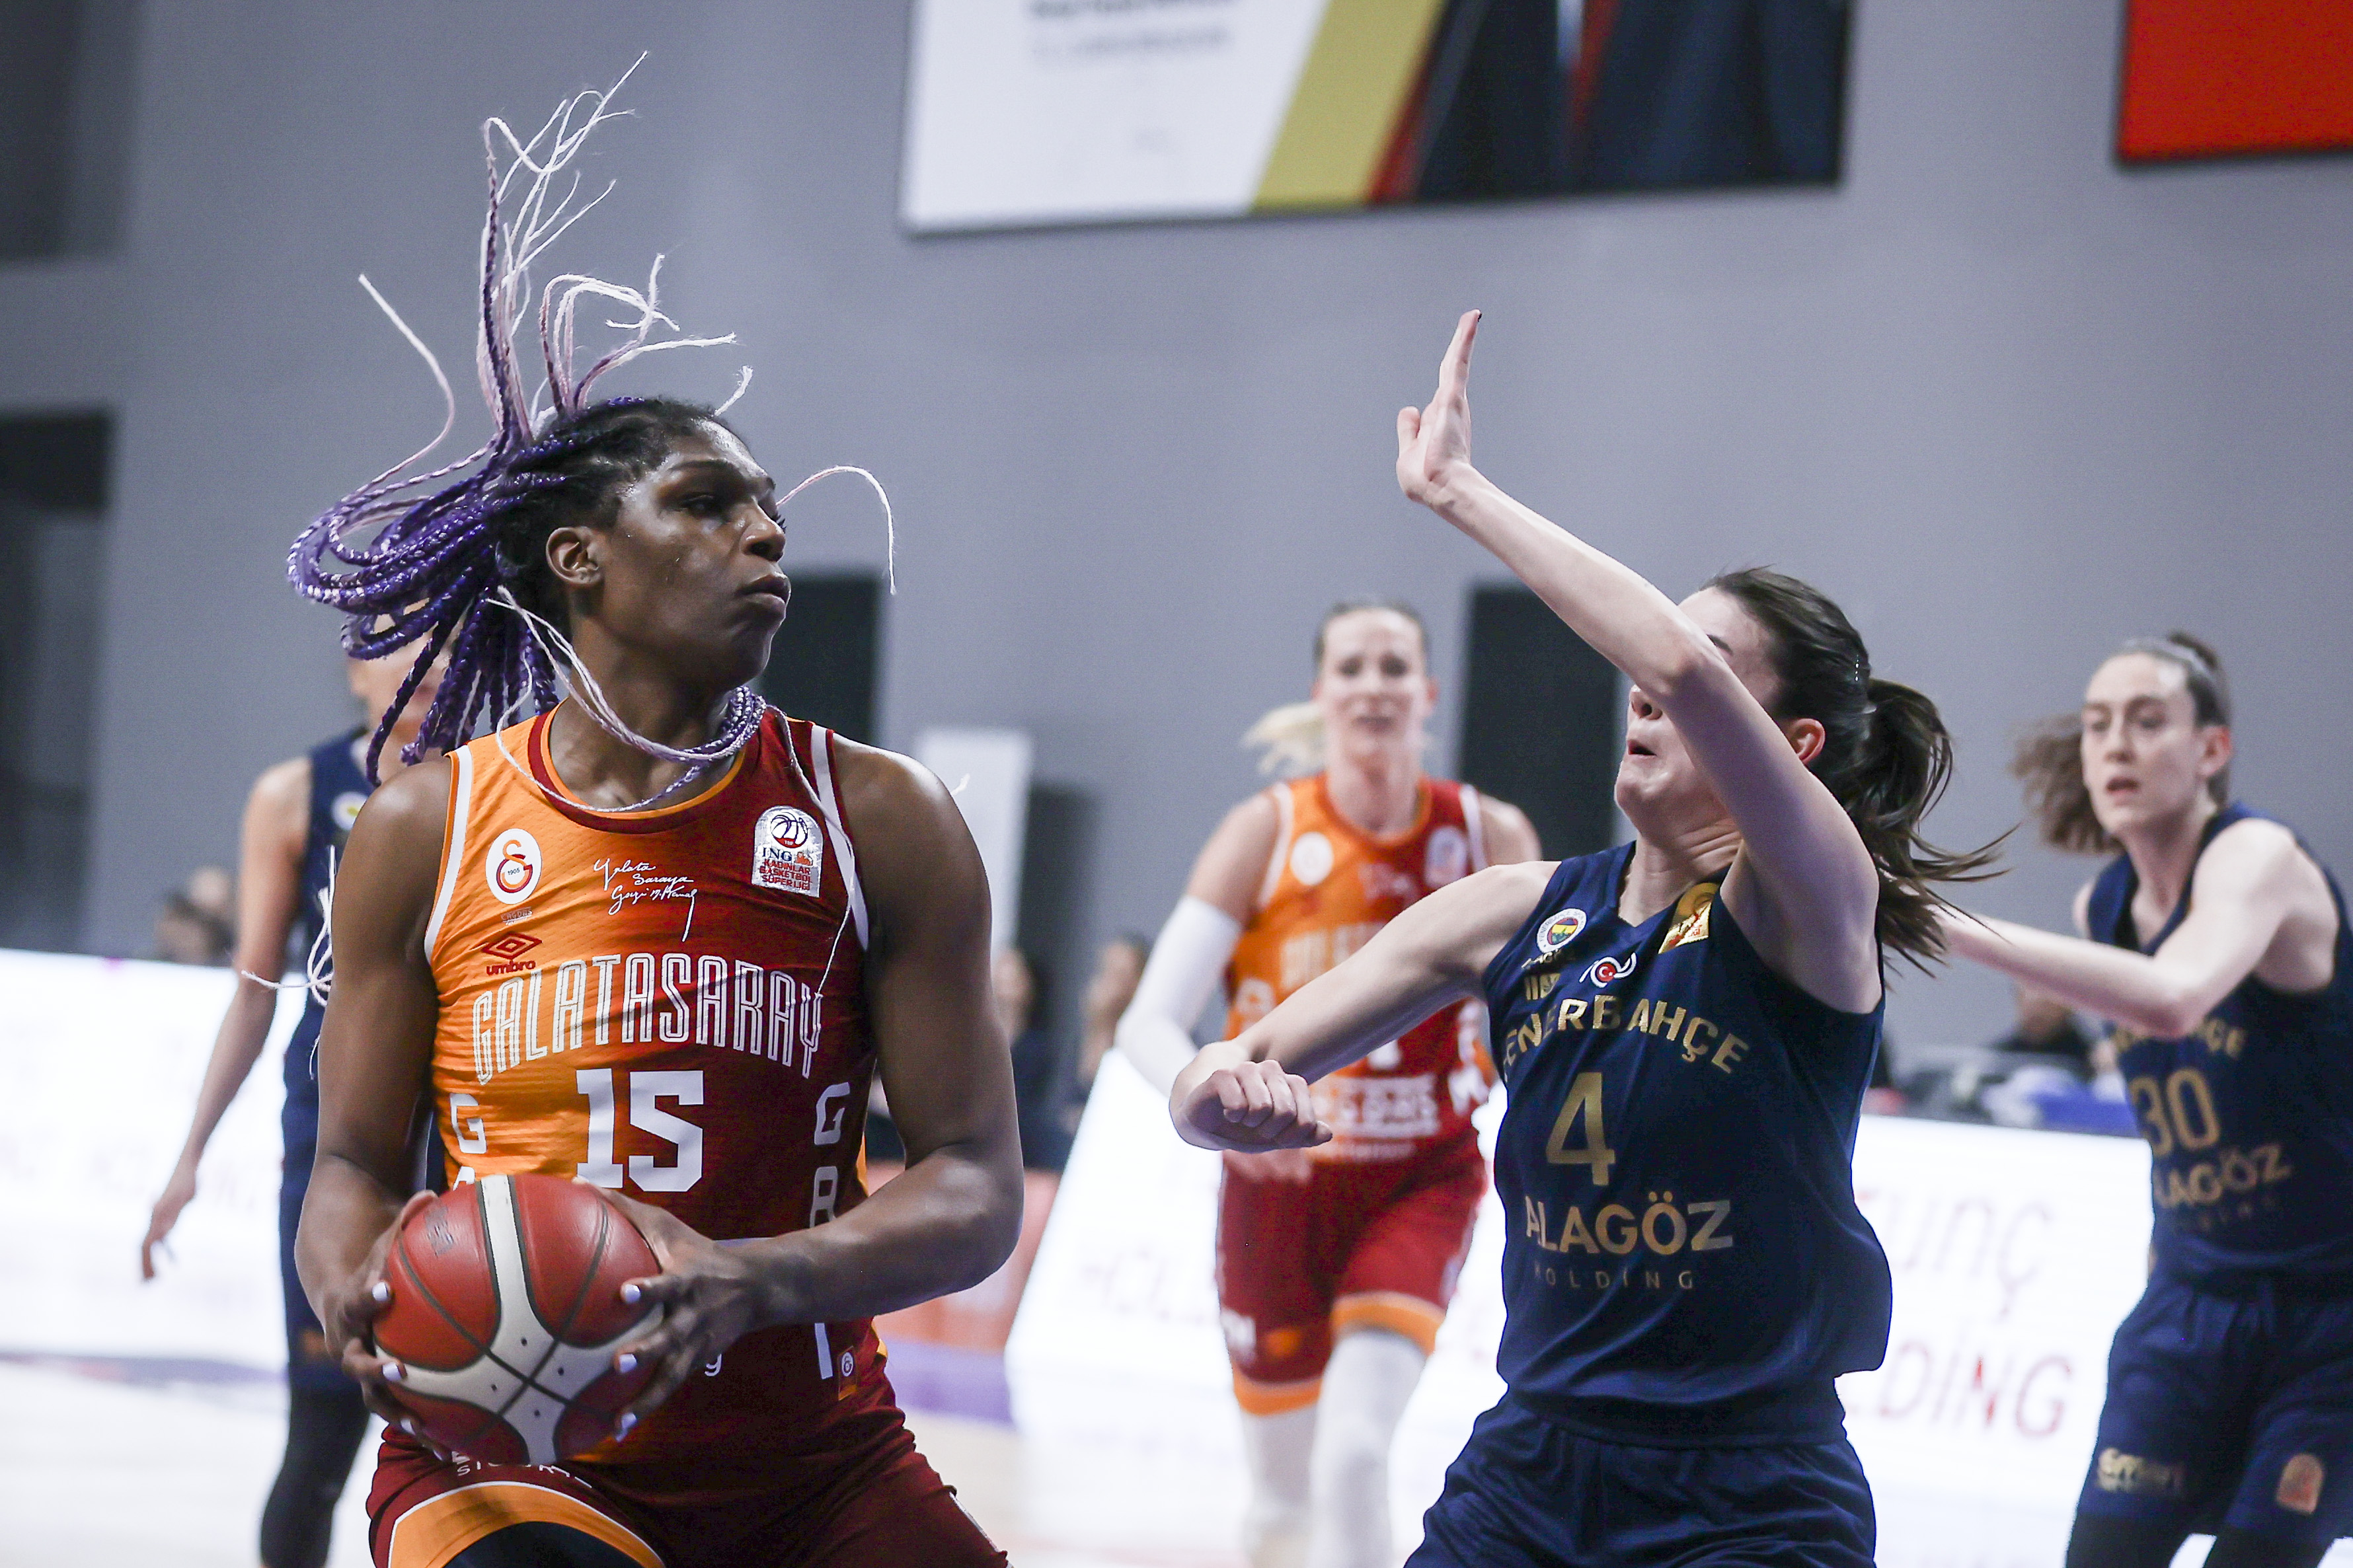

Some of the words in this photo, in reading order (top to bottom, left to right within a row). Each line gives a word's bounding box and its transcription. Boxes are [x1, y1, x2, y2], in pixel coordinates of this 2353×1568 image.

[762, 847, 792, 862] ING
[763, 859, 810, 876] KADINLAR
[486, 961, 536, 976] umbro
[473, 953, 822, 1086] GALATASARAY
[1503, 994, 1750, 1082] ENERBAHÇE
[576, 1068, 704, 1192] 15
[1545, 1072, 1615, 1186] 4
[2128, 1067, 2221, 1160] 30
[1525, 1191, 1733, 1255] ALAGÖZ
